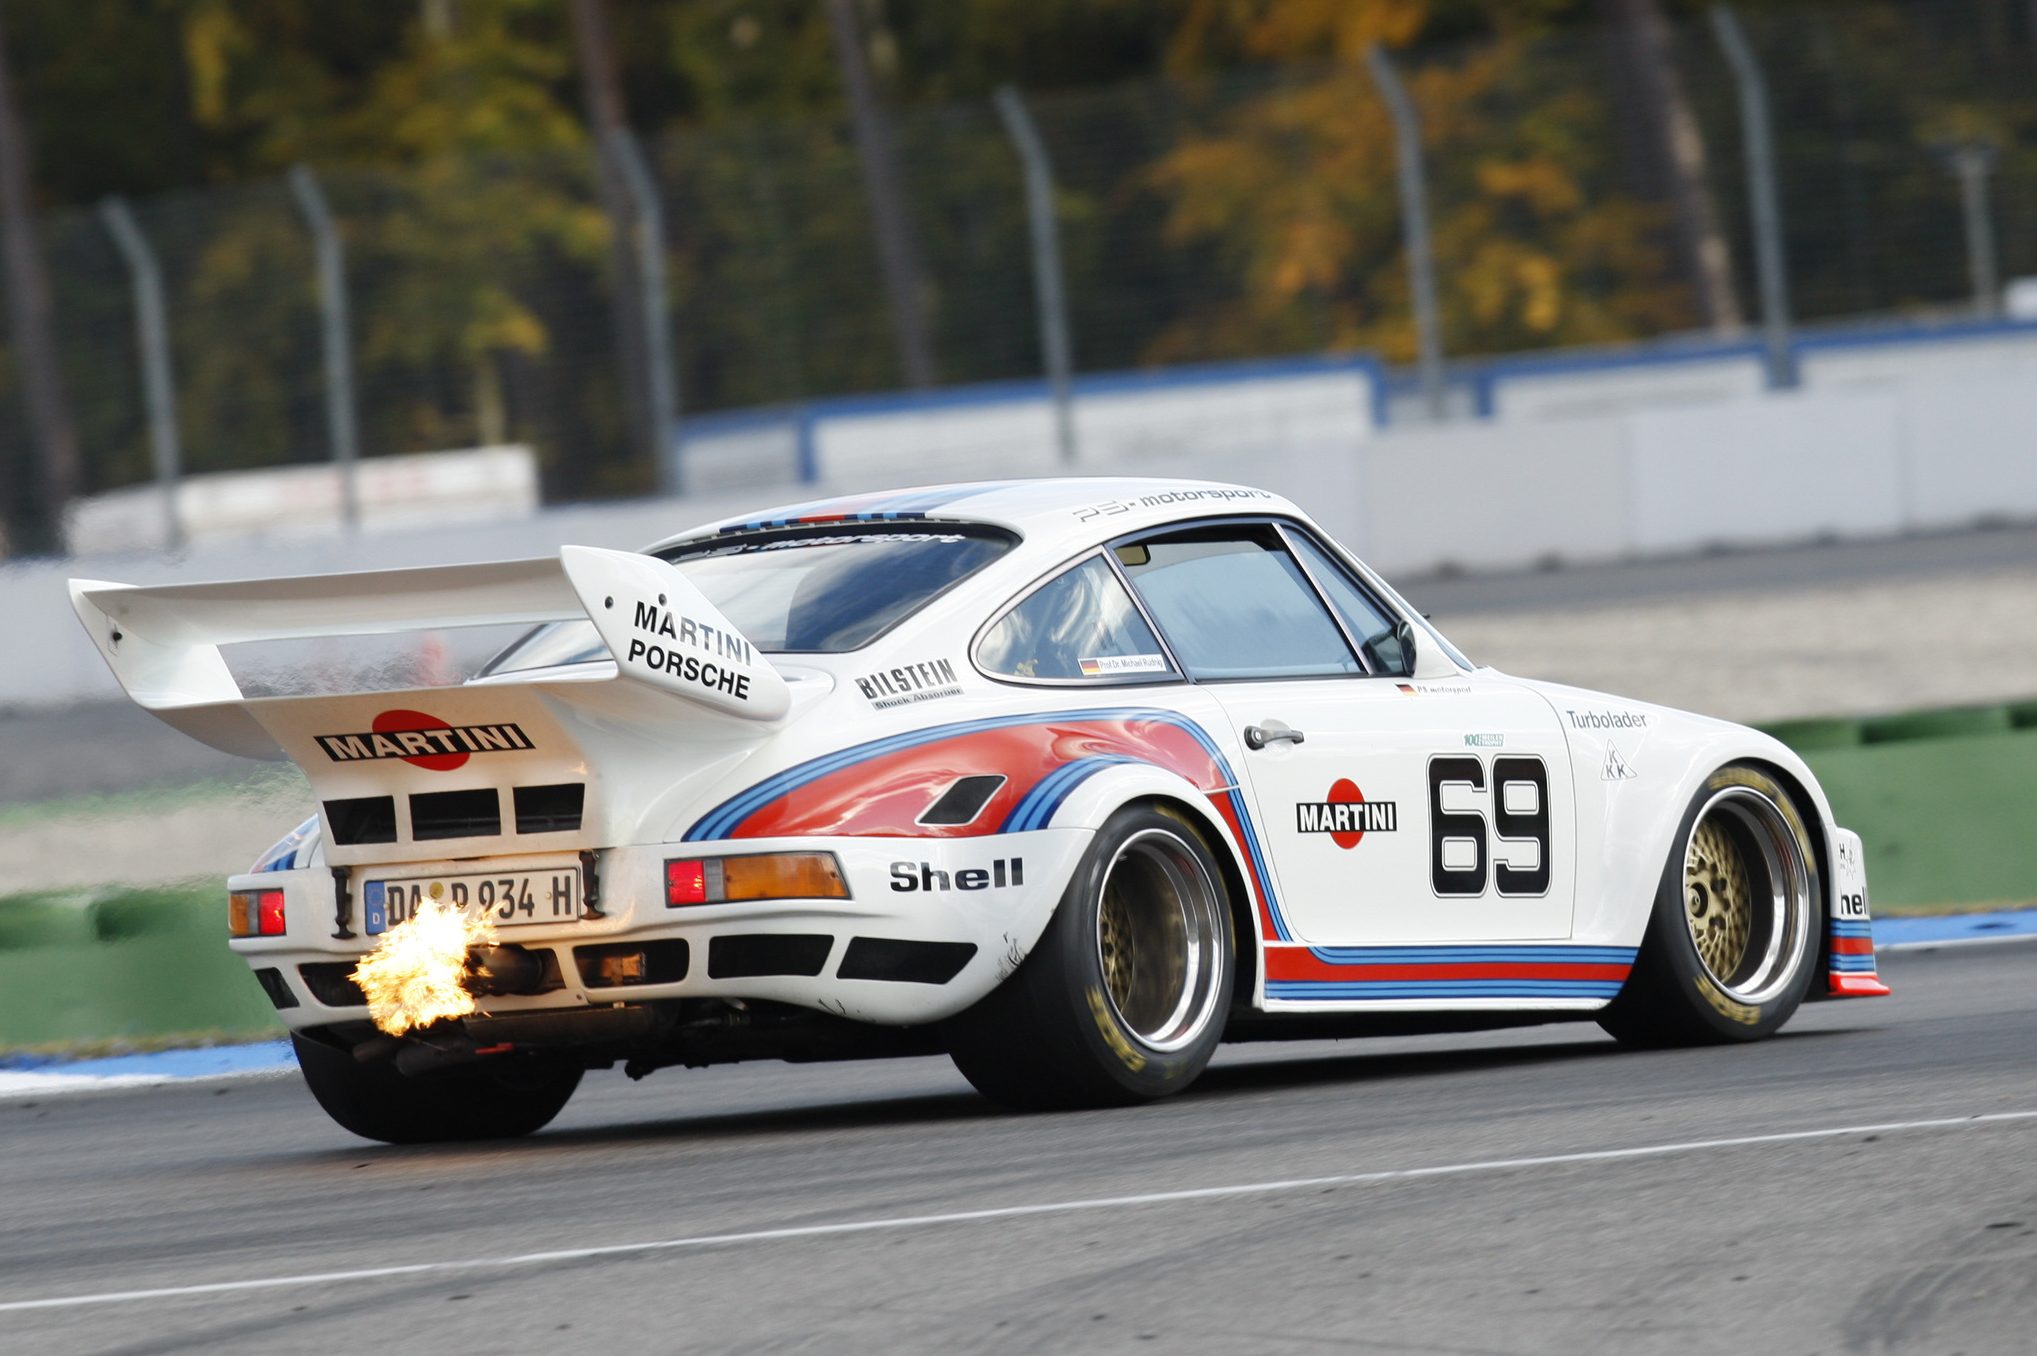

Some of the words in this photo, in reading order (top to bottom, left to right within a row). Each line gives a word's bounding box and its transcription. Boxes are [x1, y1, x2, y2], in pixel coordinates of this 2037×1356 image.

[634, 600, 751, 666] MARTINI
[628, 638, 751, 700] PORSCHE
[854, 658, 958, 700] BILSTEIN
[1566, 710, 1647, 729] Turbolader
[325, 724, 527, 760] MARTINI
[1299, 803, 1394, 832] MARTINI
[1428, 756, 1550, 895] 69
[889, 857, 1024, 892] Shell
[372, 912, 381, 925] D
[387, 884, 422, 926] DA
[478, 878, 535, 919] 934
[552, 875, 571, 916] H
